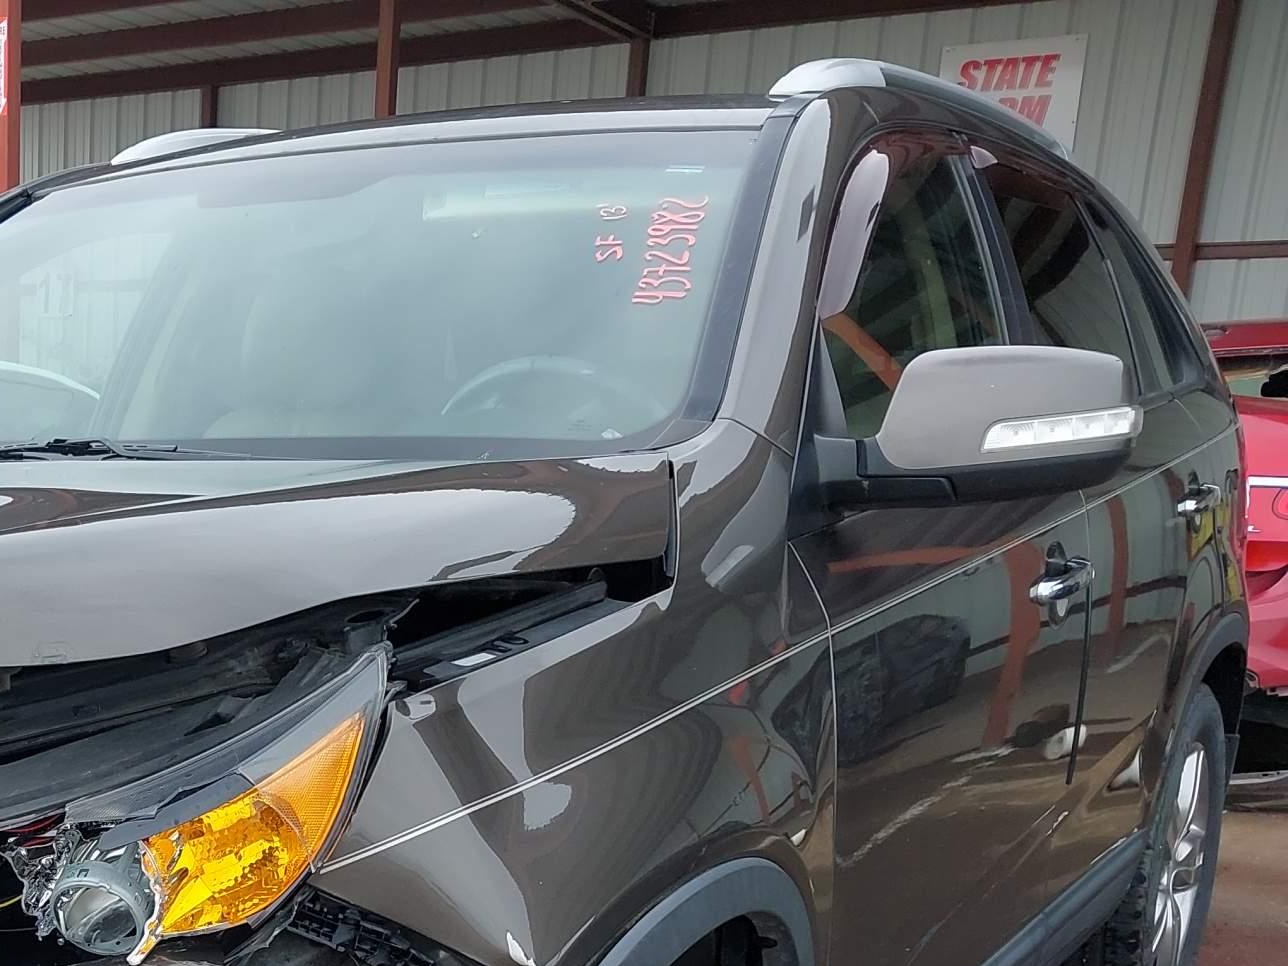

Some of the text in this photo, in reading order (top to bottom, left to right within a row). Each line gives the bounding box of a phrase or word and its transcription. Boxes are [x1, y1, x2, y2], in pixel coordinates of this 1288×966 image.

[959, 53, 1062, 92] STATE
[594, 234, 623, 262] SF
[631, 195, 710, 304] 43723982
